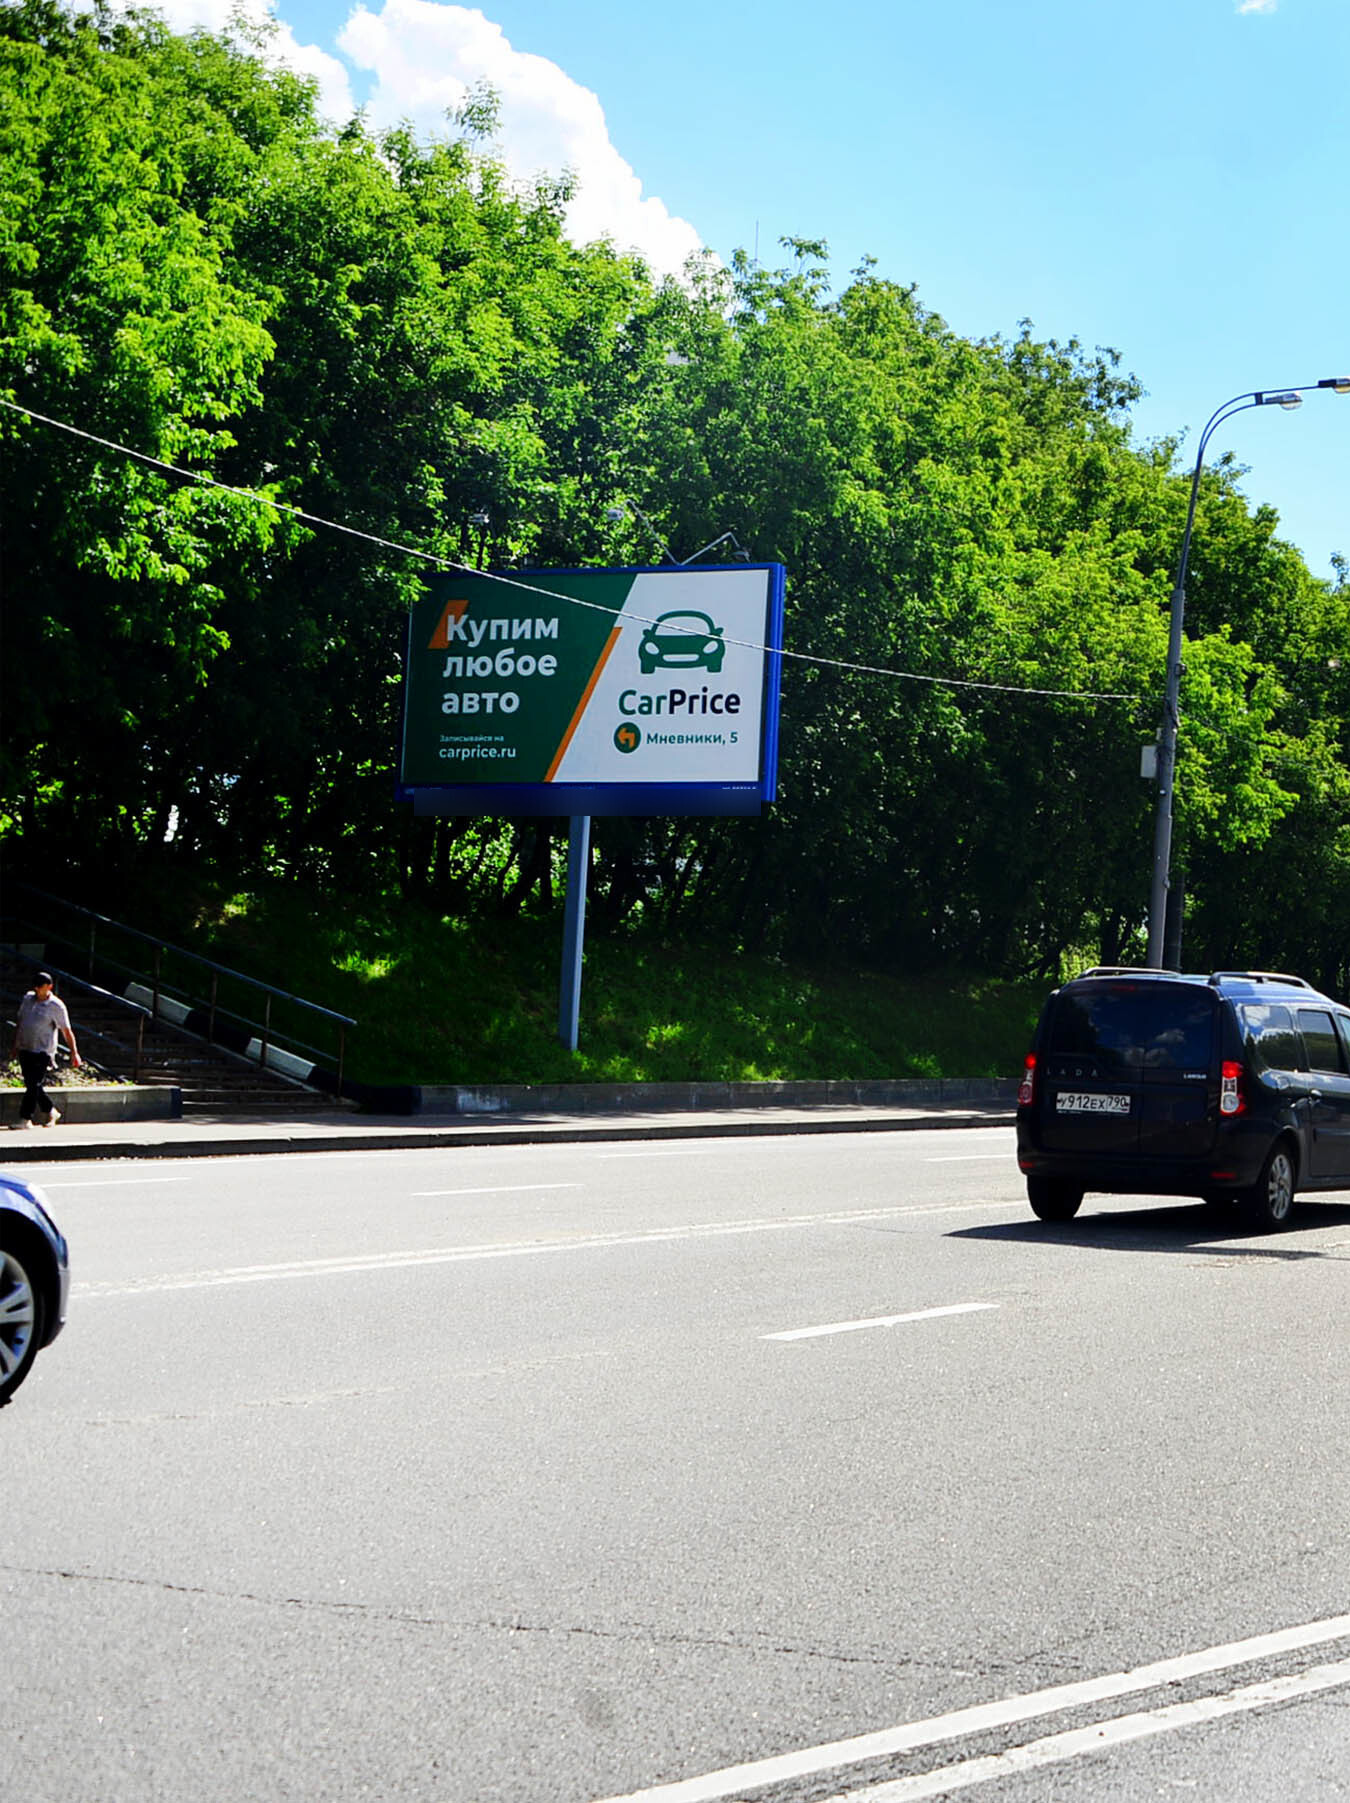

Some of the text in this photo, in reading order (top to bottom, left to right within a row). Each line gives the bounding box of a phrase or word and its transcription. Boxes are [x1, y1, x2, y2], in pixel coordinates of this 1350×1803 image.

[446, 614, 559, 648] Купим
[442, 647, 558, 678] любое
[441, 691, 520, 714] авто
[618, 685, 741, 716] CarPrice
[646, 731, 739, 745] Мневники, 5
[439, 744, 516, 761] carprice.ru
